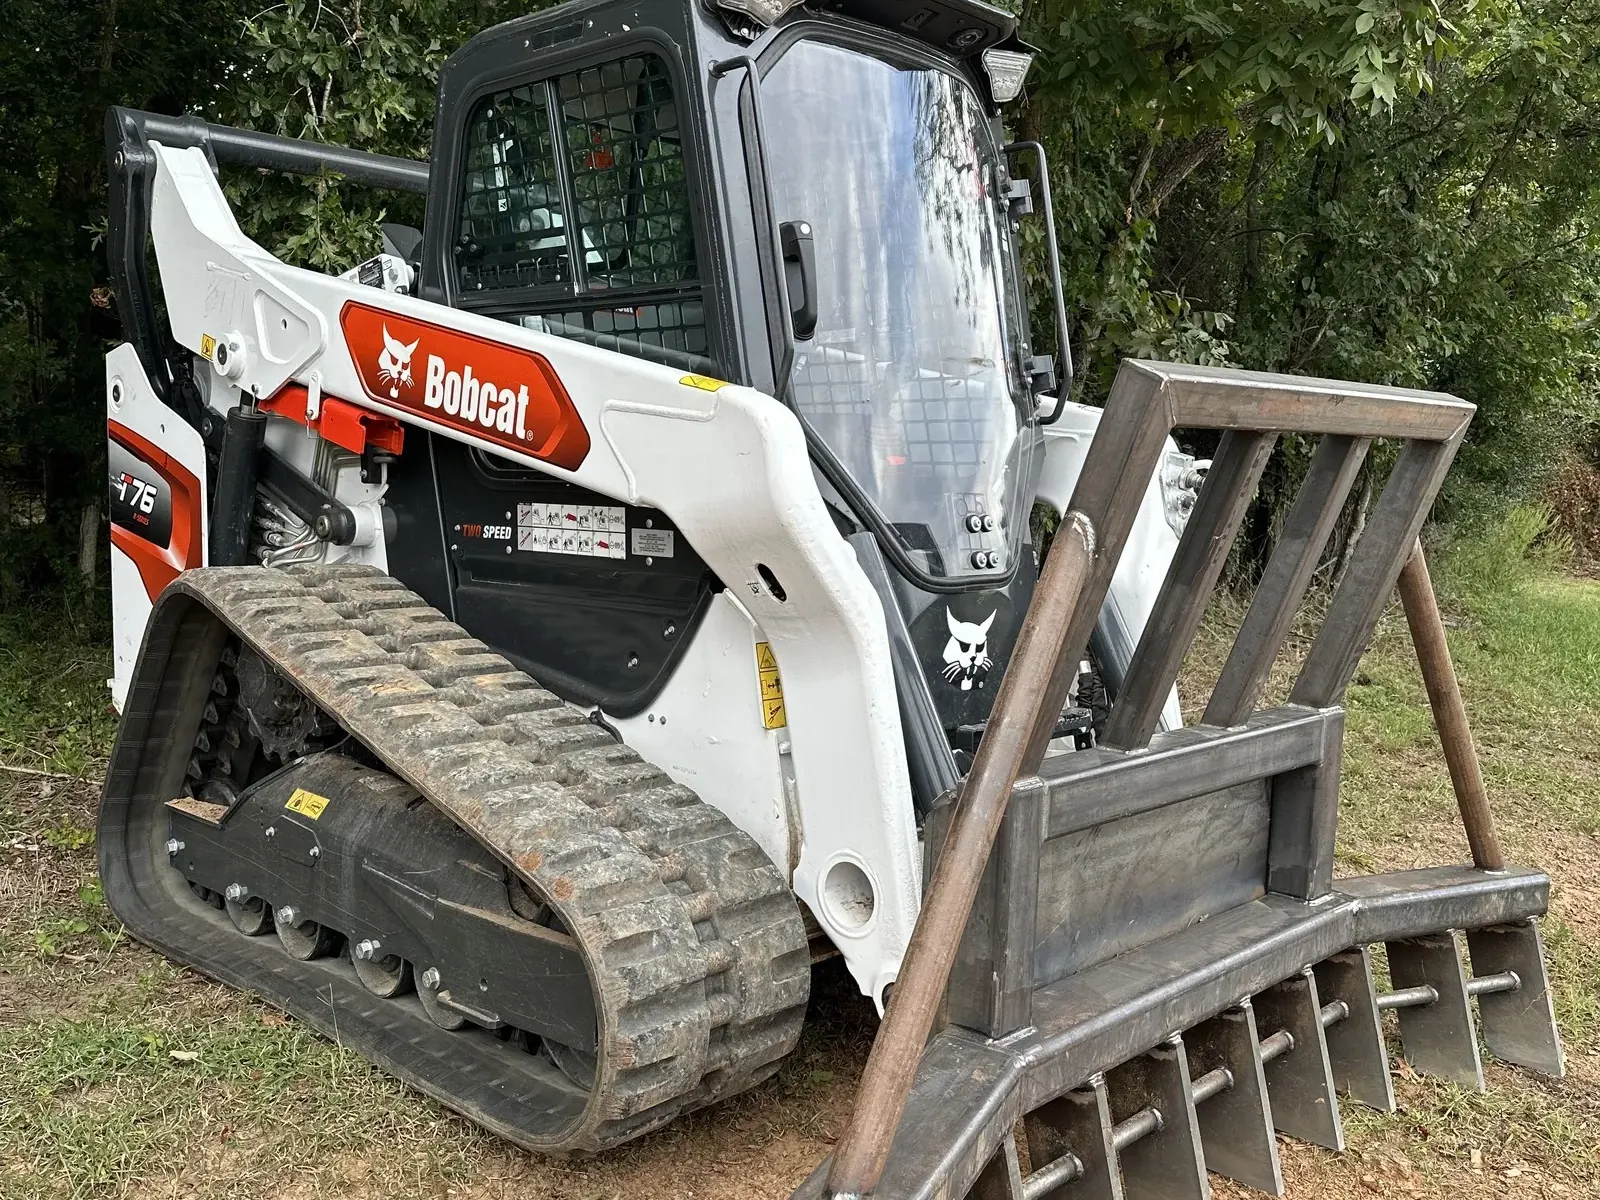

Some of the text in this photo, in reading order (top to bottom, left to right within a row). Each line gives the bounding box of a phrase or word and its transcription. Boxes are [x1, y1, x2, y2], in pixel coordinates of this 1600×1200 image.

[424, 353, 529, 440] Bobcat
[120, 472, 158, 514] T76
[463, 525, 512, 540] TWO SPEED
